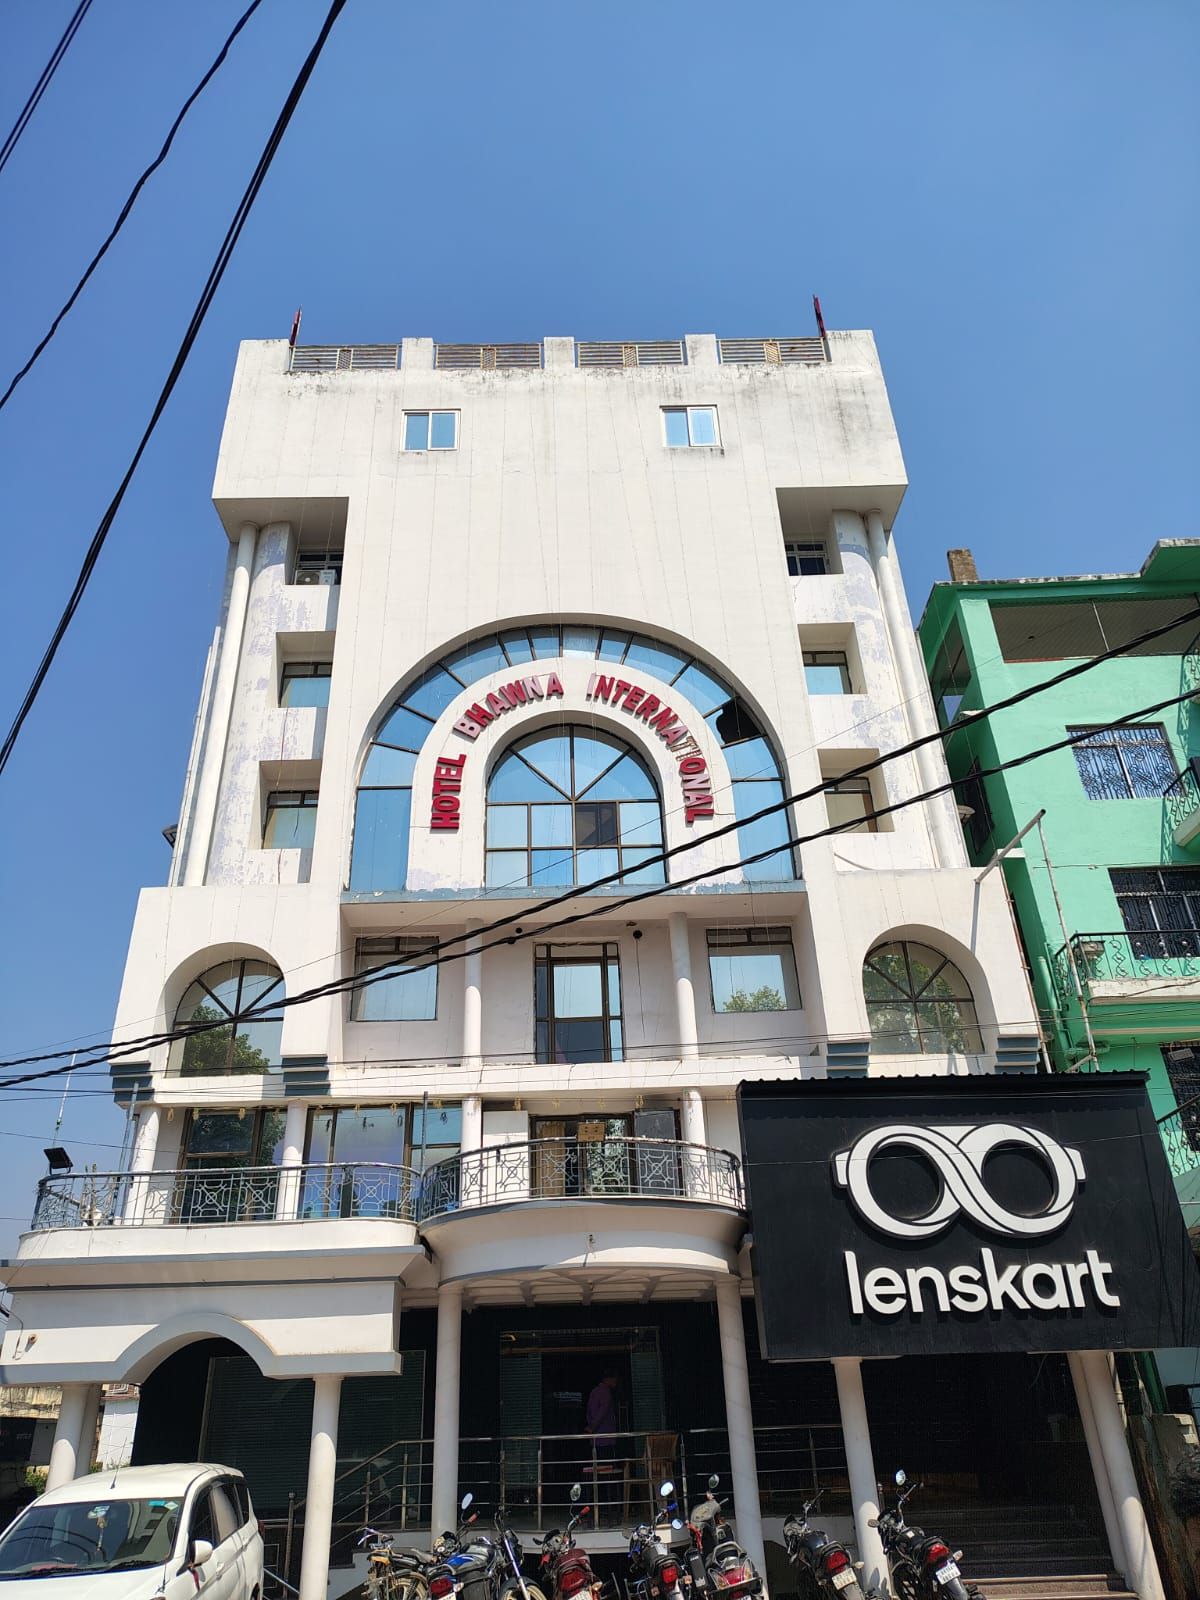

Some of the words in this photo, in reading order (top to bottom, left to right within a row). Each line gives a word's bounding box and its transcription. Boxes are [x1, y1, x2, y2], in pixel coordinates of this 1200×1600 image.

[431, 753, 467, 829] HOTEL
[453, 672, 565, 739] BHAWNA
[586, 672, 715, 823] INTERNATIONAL
[843, 1247, 1120, 1314] lenskart
